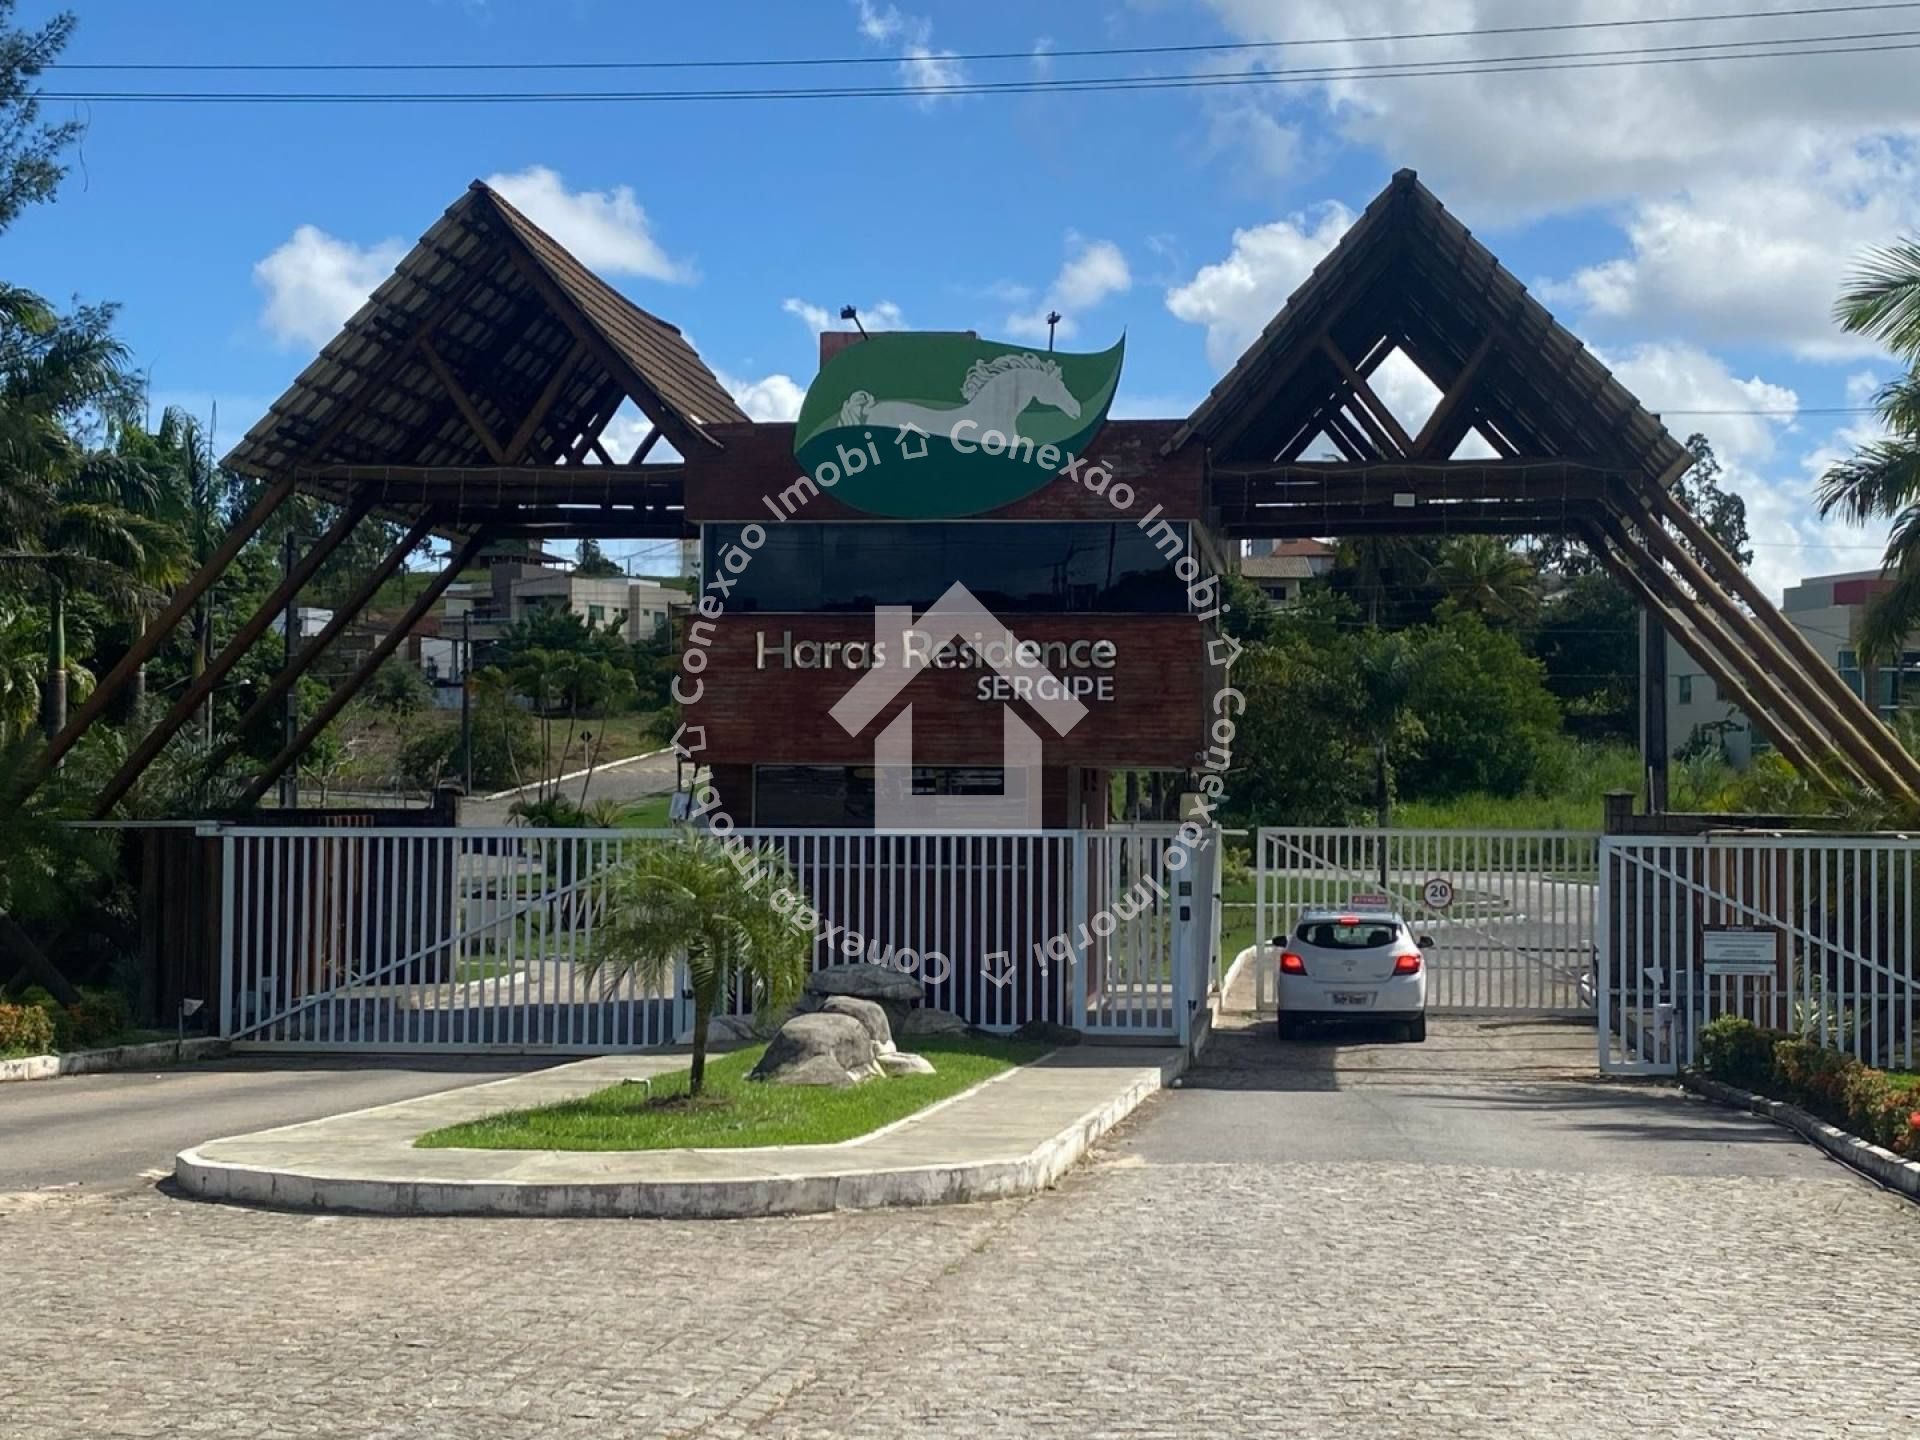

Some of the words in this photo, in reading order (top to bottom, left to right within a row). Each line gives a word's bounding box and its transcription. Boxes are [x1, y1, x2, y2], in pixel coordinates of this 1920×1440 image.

[756, 630, 886, 669] Haras
[902, 629, 1117, 669] Residence
[976, 675, 1116, 701] SERGIPE
[1430, 885, 1448, 898] 20
